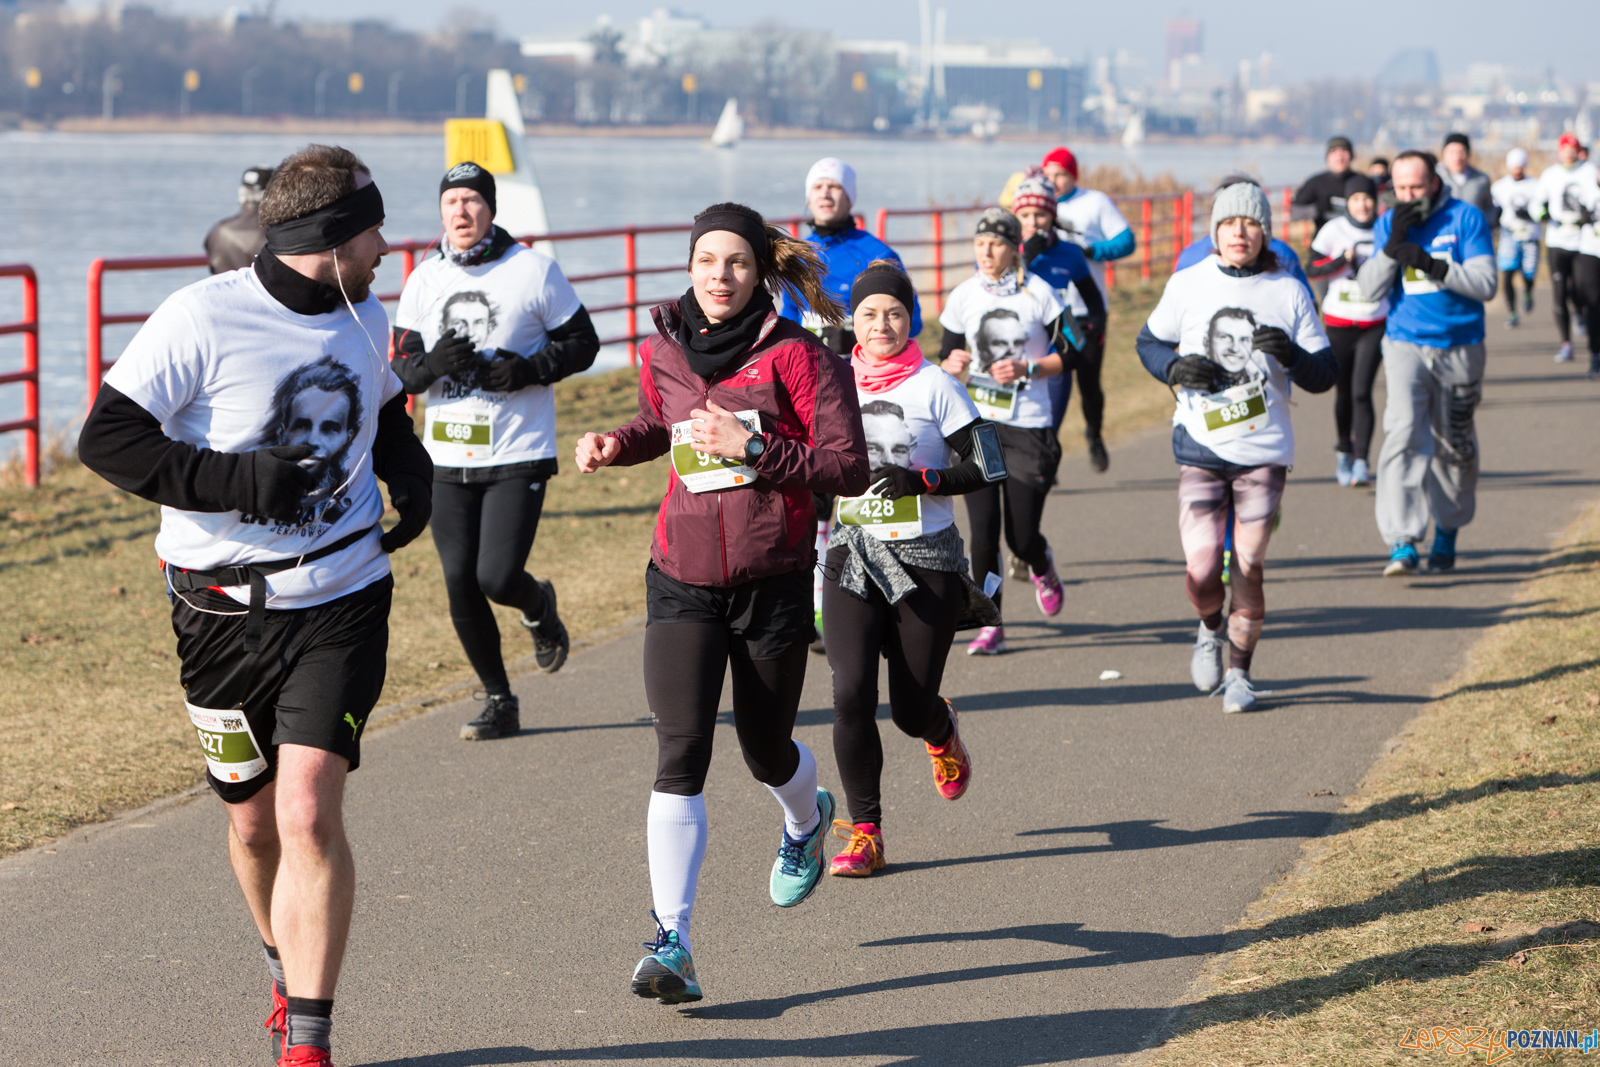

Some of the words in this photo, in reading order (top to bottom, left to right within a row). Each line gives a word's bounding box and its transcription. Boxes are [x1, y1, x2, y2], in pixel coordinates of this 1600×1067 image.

[1220, 402, 1249, 422] 938
[445, 423, 472, 440] 669
[860, 500, 895, 518] 428
[197, 729, 224, 754] 627
